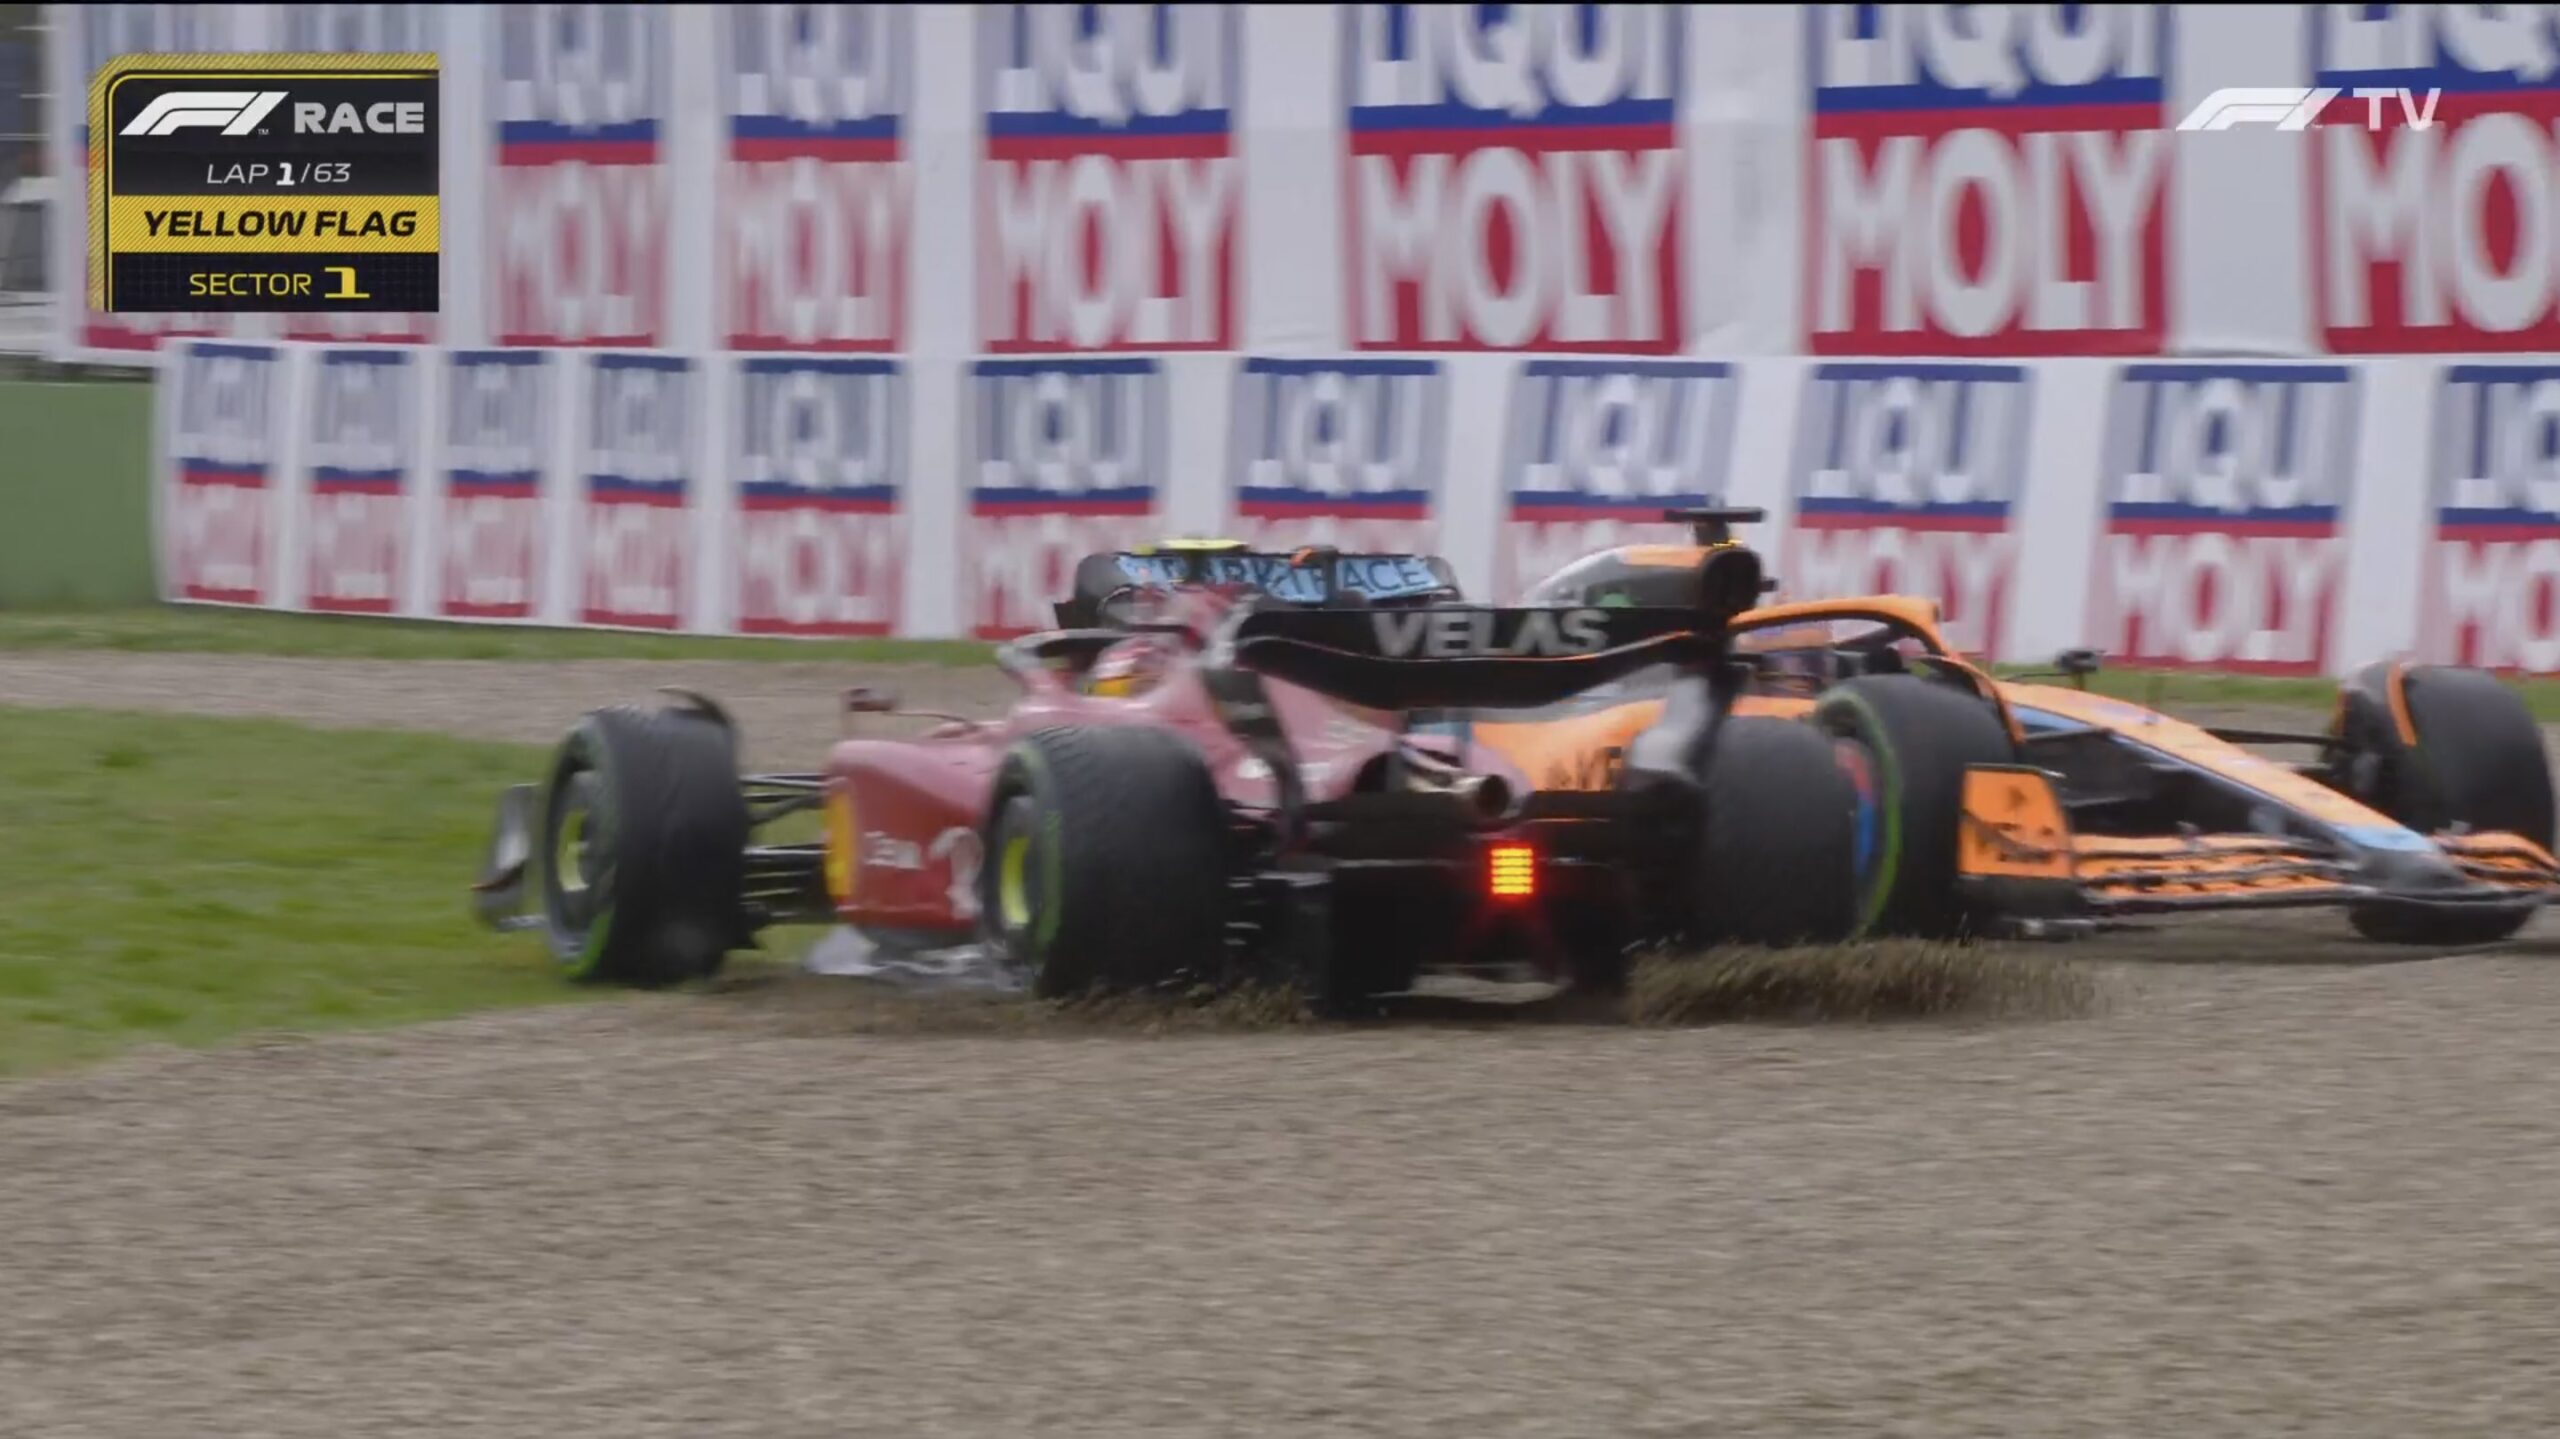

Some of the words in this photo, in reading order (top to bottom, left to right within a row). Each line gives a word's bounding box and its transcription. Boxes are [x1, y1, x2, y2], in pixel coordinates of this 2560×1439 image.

[992, 155, 1237, 348] MOLY
[1358, 147, 1678, 347] MOLY
[1812, 128, 2166, 337] MOLY
[2319, 112, 2560, 332] MO
[1371, 609, 1609, 657] VELAS
